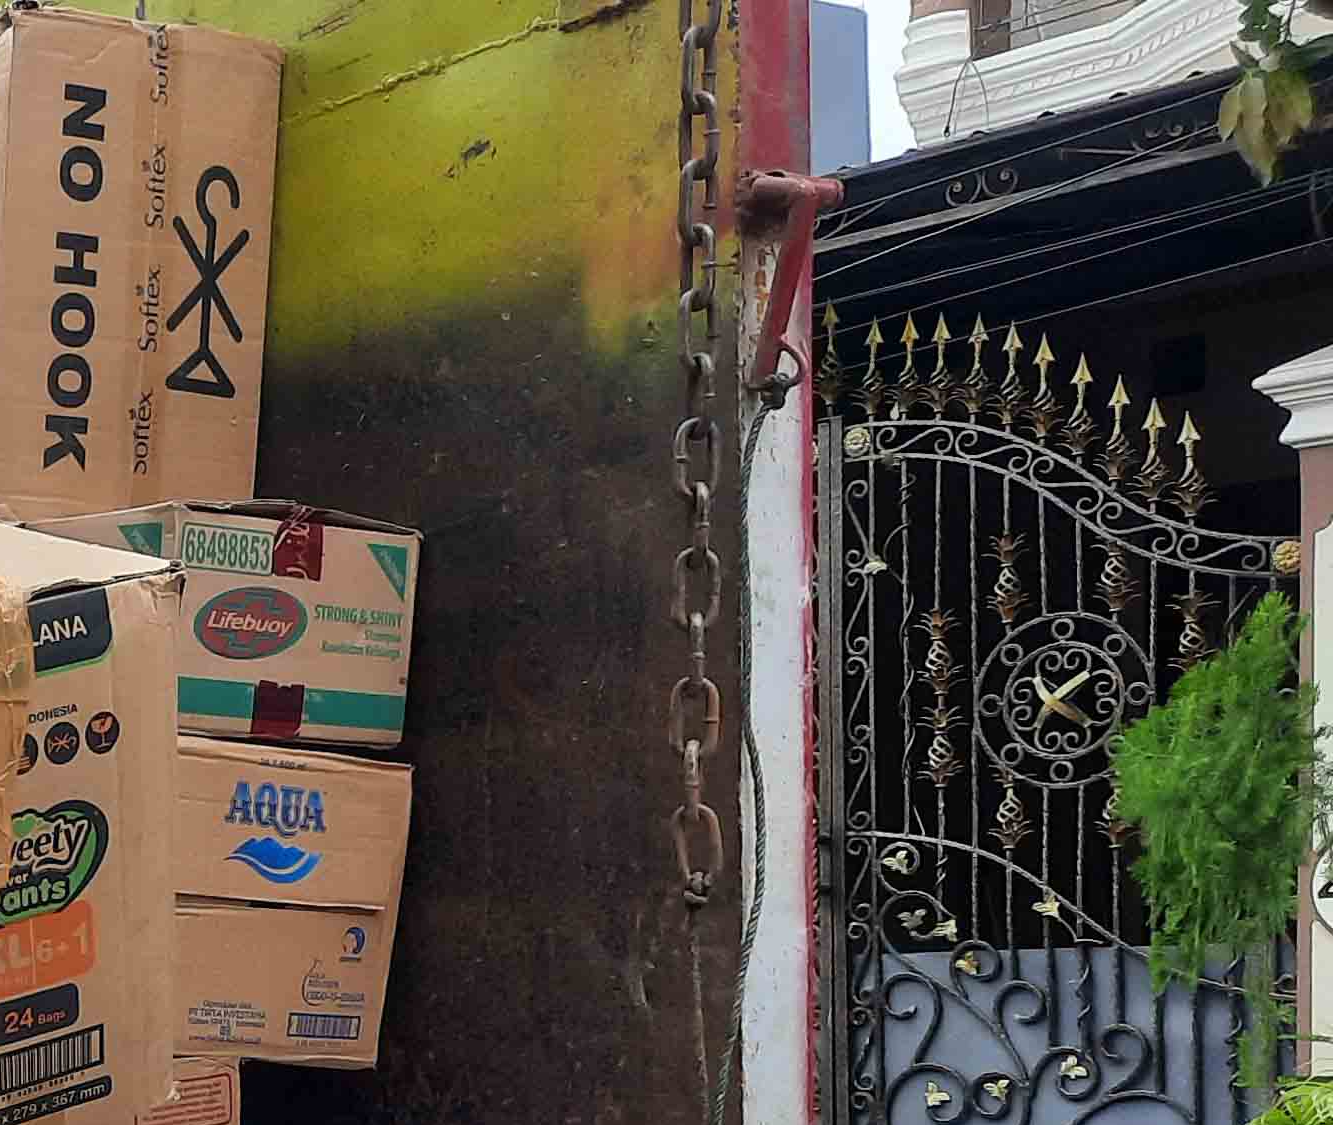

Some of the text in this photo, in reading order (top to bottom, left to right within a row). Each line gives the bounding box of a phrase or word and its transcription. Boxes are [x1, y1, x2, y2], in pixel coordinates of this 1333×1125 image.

[143, 143, 167, 229] Softex
[41, 82, 108, 472] NO HOOK
[136, 264, 162, 354] Softex
[131, 390, 153, 476] Softex
[185, 527, 271, 571] 68498853
[206, 609, 294, 638] Lifebuoy
[314, 603, 357, 624] STRONG
[368, 608, 405, 629] SHINY
[224, 779, 327, 838] AQUA
[4, 1007, 34, 1035] 24
[13, 1103, 37, 1122] 279
[78, 1083, 106, 1100] mm
